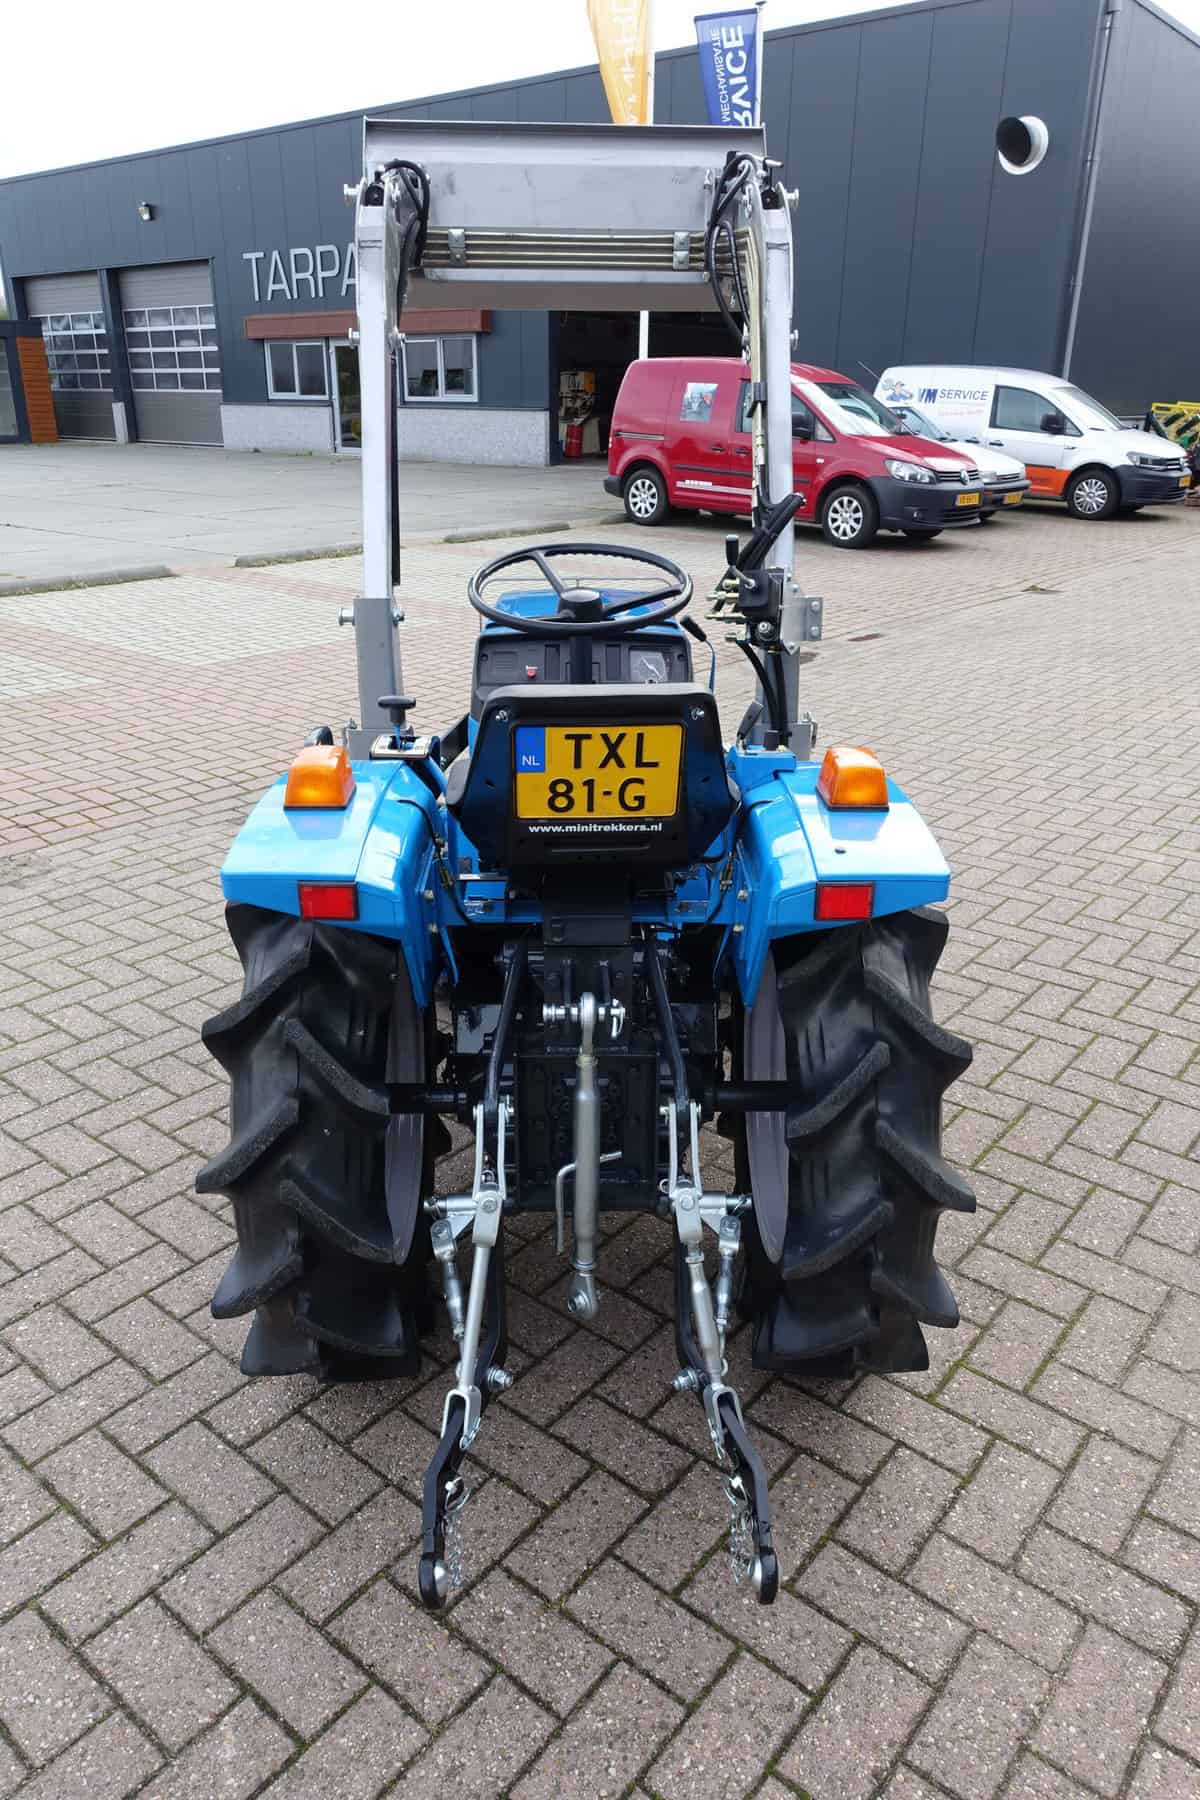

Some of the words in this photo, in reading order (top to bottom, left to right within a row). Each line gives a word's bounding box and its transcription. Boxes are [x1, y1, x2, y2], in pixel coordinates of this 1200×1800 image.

[939, 389, 989, 401] SERVICE
[564, 732, 660, 770] TXL
[521, 754, 541, 767] NL
[547, 777, 646, 813] 81-G
[528, 821, 663, 834] www.minitrekkers.nl
